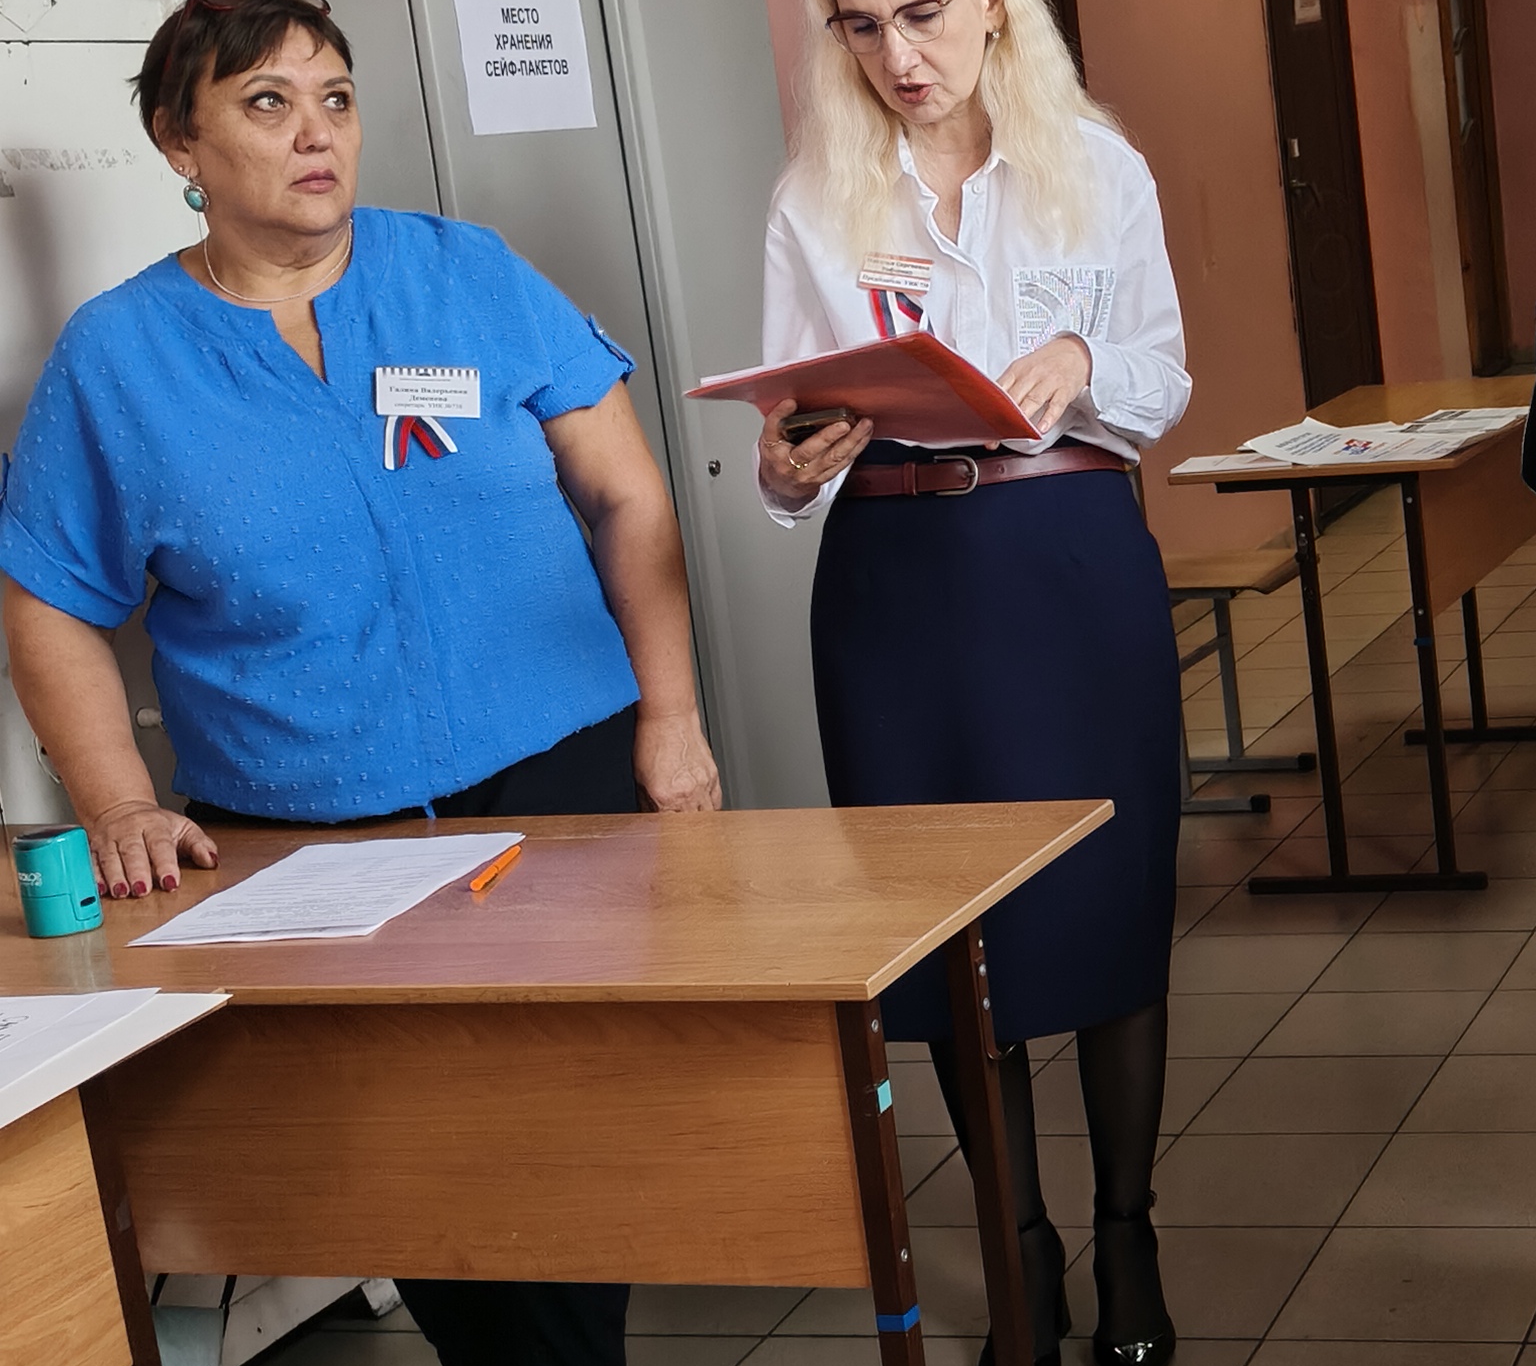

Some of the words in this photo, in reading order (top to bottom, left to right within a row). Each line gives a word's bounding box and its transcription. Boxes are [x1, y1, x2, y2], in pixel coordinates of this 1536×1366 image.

[501, 7, 540, 25] МЕСТО
[494, 33, 554, 51] ХРАНЕНИЯ
[484, 57, 570, 78] СЕЙФ-ПАКЕТОВ
